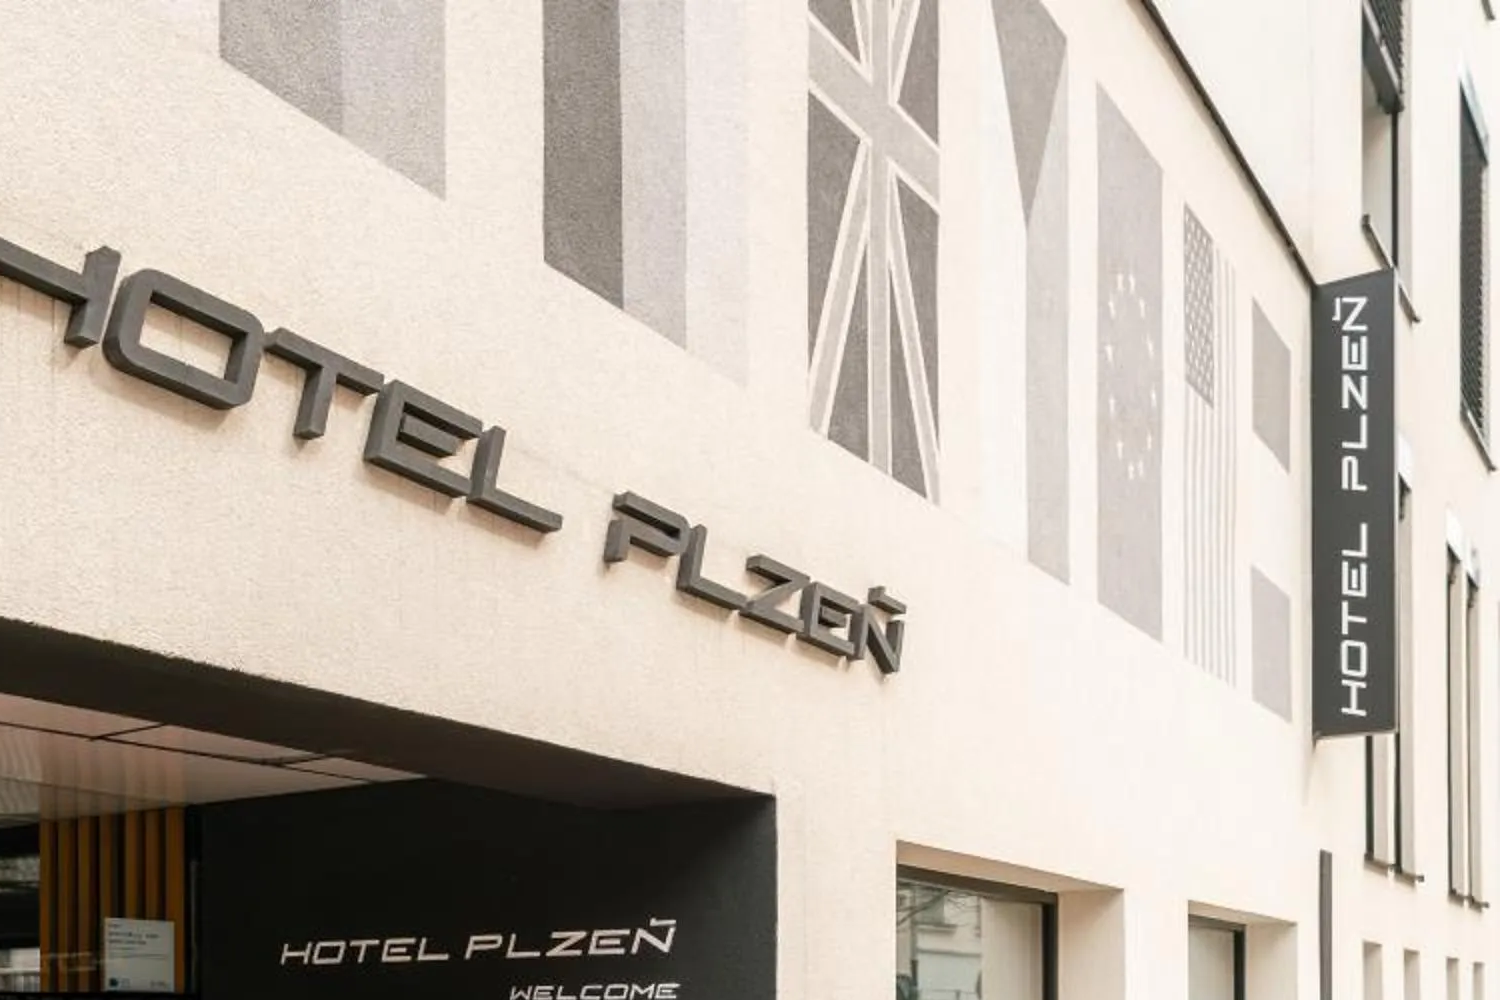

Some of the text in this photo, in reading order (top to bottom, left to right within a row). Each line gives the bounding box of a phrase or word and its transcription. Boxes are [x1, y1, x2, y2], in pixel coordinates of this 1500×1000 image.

[1332, 296, 1369, 718] HOTEL PLZEŇ
[603, 490, 907, 674] PLZEŇ
[280, 918, 677, 966] HOTEL PLZEŇ
[509, 983, 681, 1000] WELCOME
